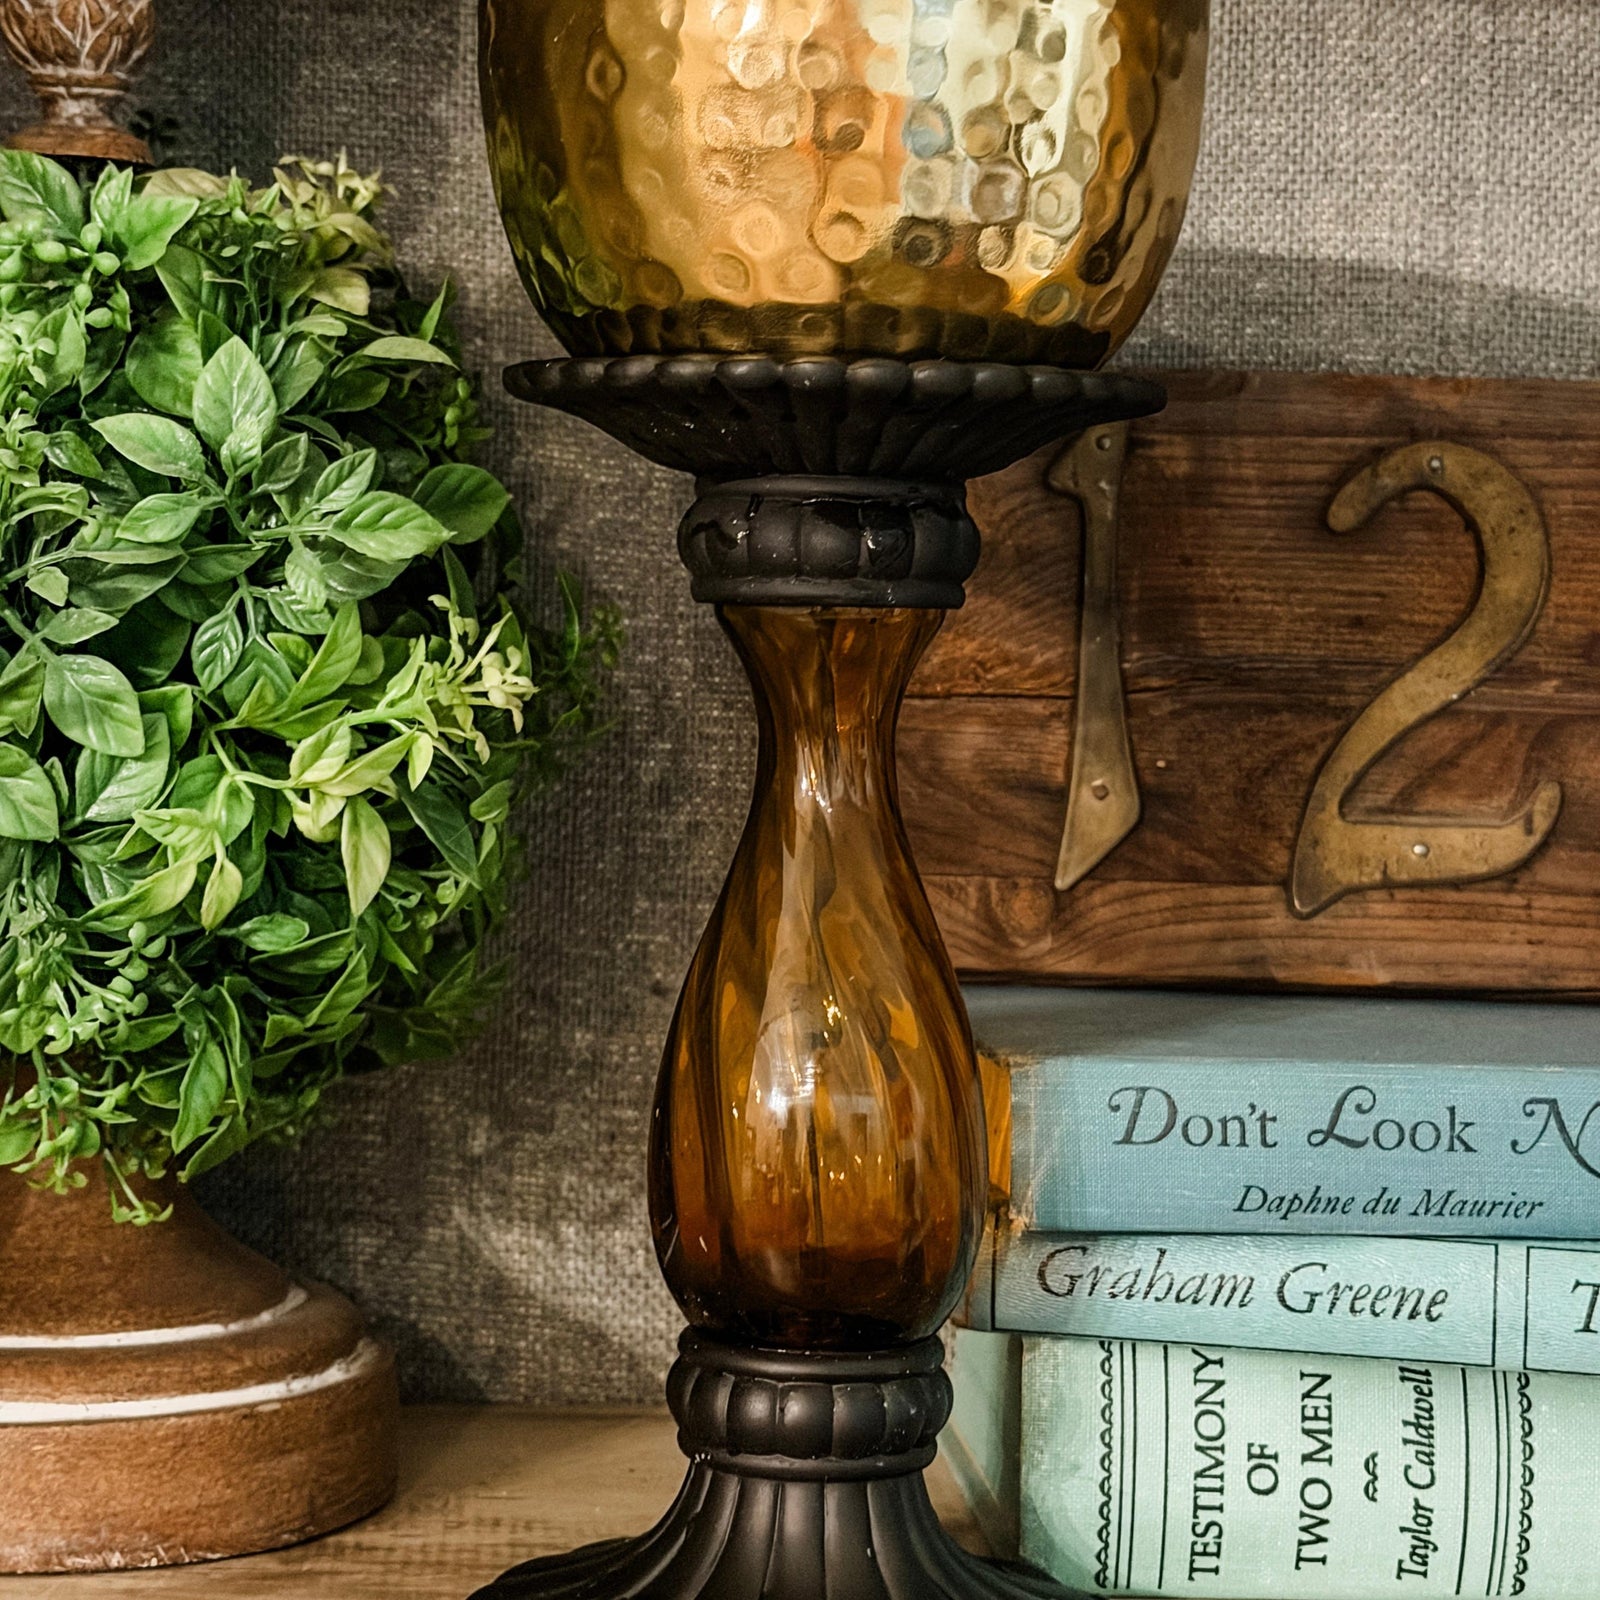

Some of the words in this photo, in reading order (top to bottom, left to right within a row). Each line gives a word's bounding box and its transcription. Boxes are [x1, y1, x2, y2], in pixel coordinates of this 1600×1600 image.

[1108, 1086, 1278, 1147] Don't
[1307, 1085, 1478, 1153] Look
[1233, 1184, 1355, 1220] Daphne
[1362, 1186, 1401, 1216] du
[1410, 1188, 1544, 1220] Maurier
[1037, 1246, 1255, 1309] Graham
[1277, 1261, 1449, 1323] Greene
[1299, 1369, 1334, 1467] MEN
[1398, 1366, 1437, 1490] Caldwell
[1188, 1347, 1226, 1581] TESTIMONY
[1246, 1442, 1279, 1496] OF
[1294, 1477, 1333, 1571] TWO
[1396, 1497, 1439, 1580] Taylor
